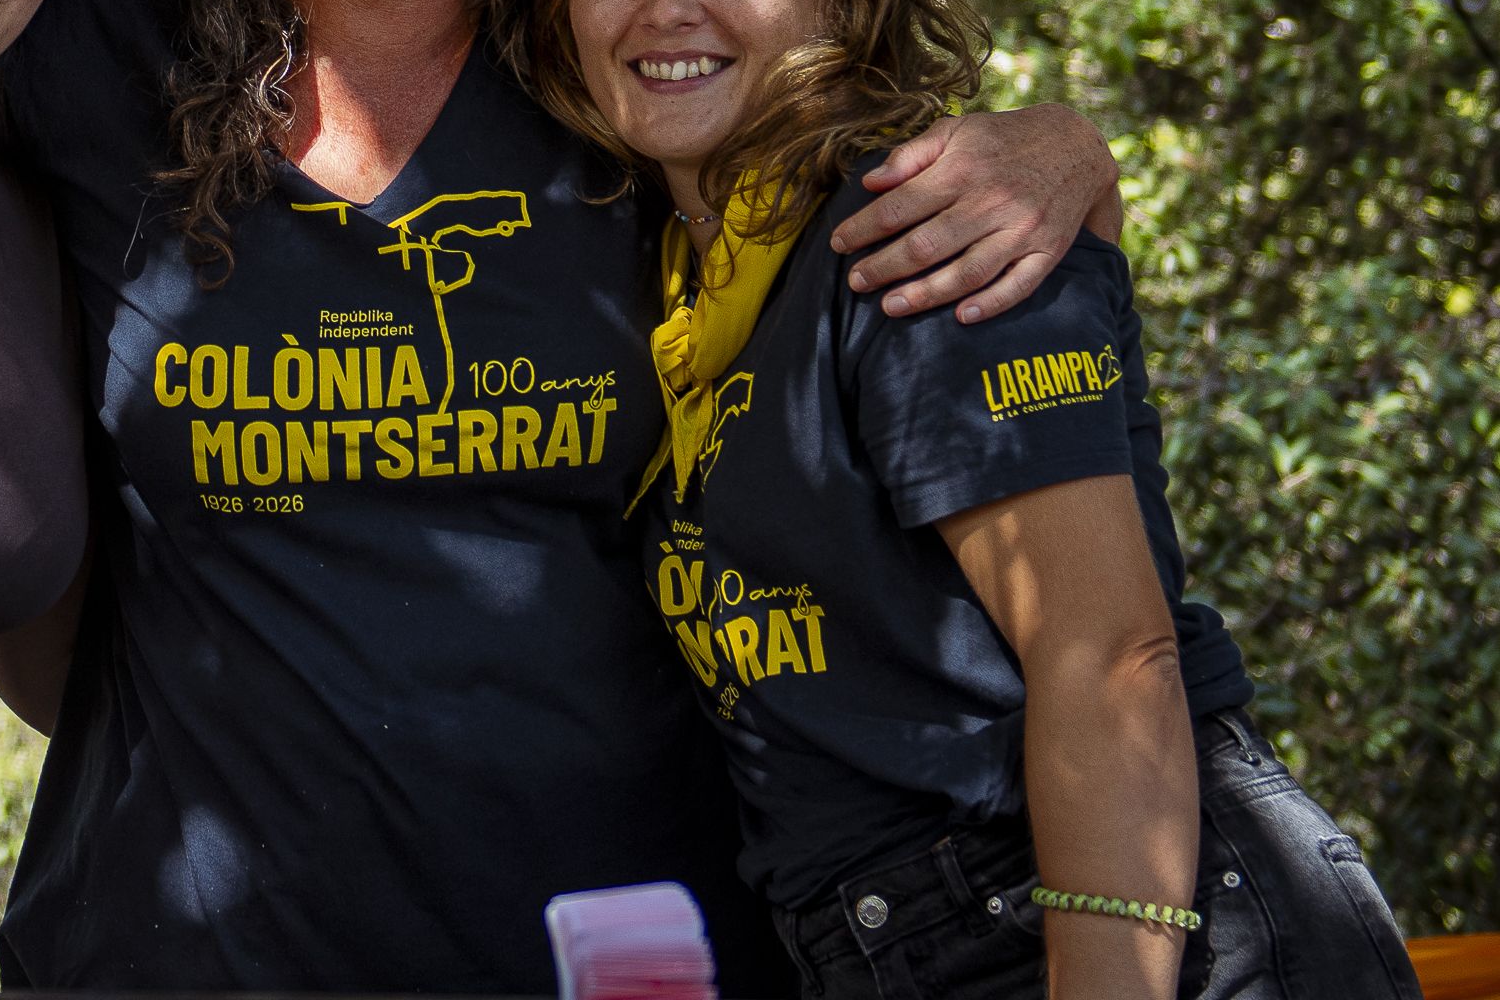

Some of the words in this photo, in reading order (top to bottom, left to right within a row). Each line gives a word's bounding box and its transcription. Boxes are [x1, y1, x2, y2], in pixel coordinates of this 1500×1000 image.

[319, 309, 394, 326] Repúblika
[319, 323, 414, 341] independent
[154, 334, 430, 411] COLÒNIA
[468, 357, 537, 398] 100
[540, 368, 616, 410] anys
[1007, 409, 1019, 419] LA
[190, 397, 618, 486] MONTSERRAT
[200, 494, 244, 513] 1926
[253, 494, 304, 513] 2026
[720, 681, 740, 710] 026
